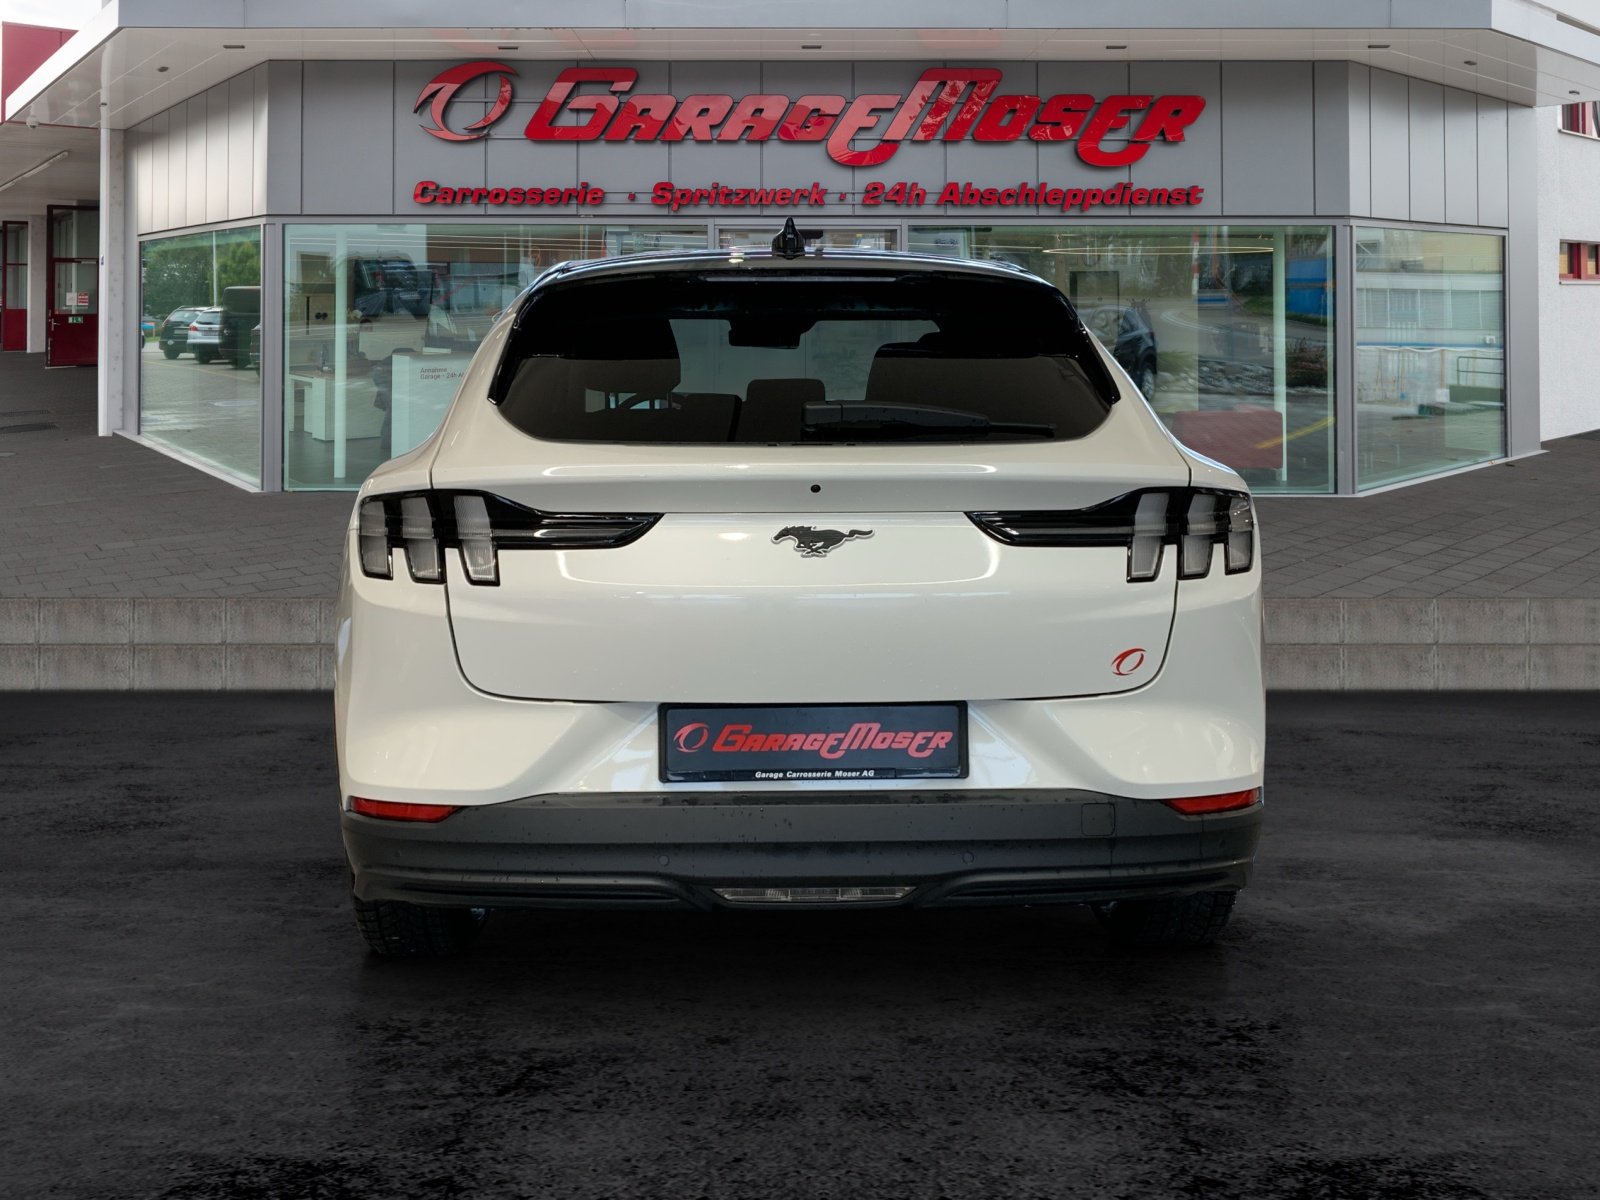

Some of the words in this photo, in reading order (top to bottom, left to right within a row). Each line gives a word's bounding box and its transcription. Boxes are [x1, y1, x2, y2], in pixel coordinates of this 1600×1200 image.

[413, 181, 604, 205] Carrosserie
[651, 181, 826, 211] Spritzwerk
[861, 181, 926, 205] 24h
[936, 181, 1204, 211] Abschleppdienst
[755, 771, 784, 779] Garage
